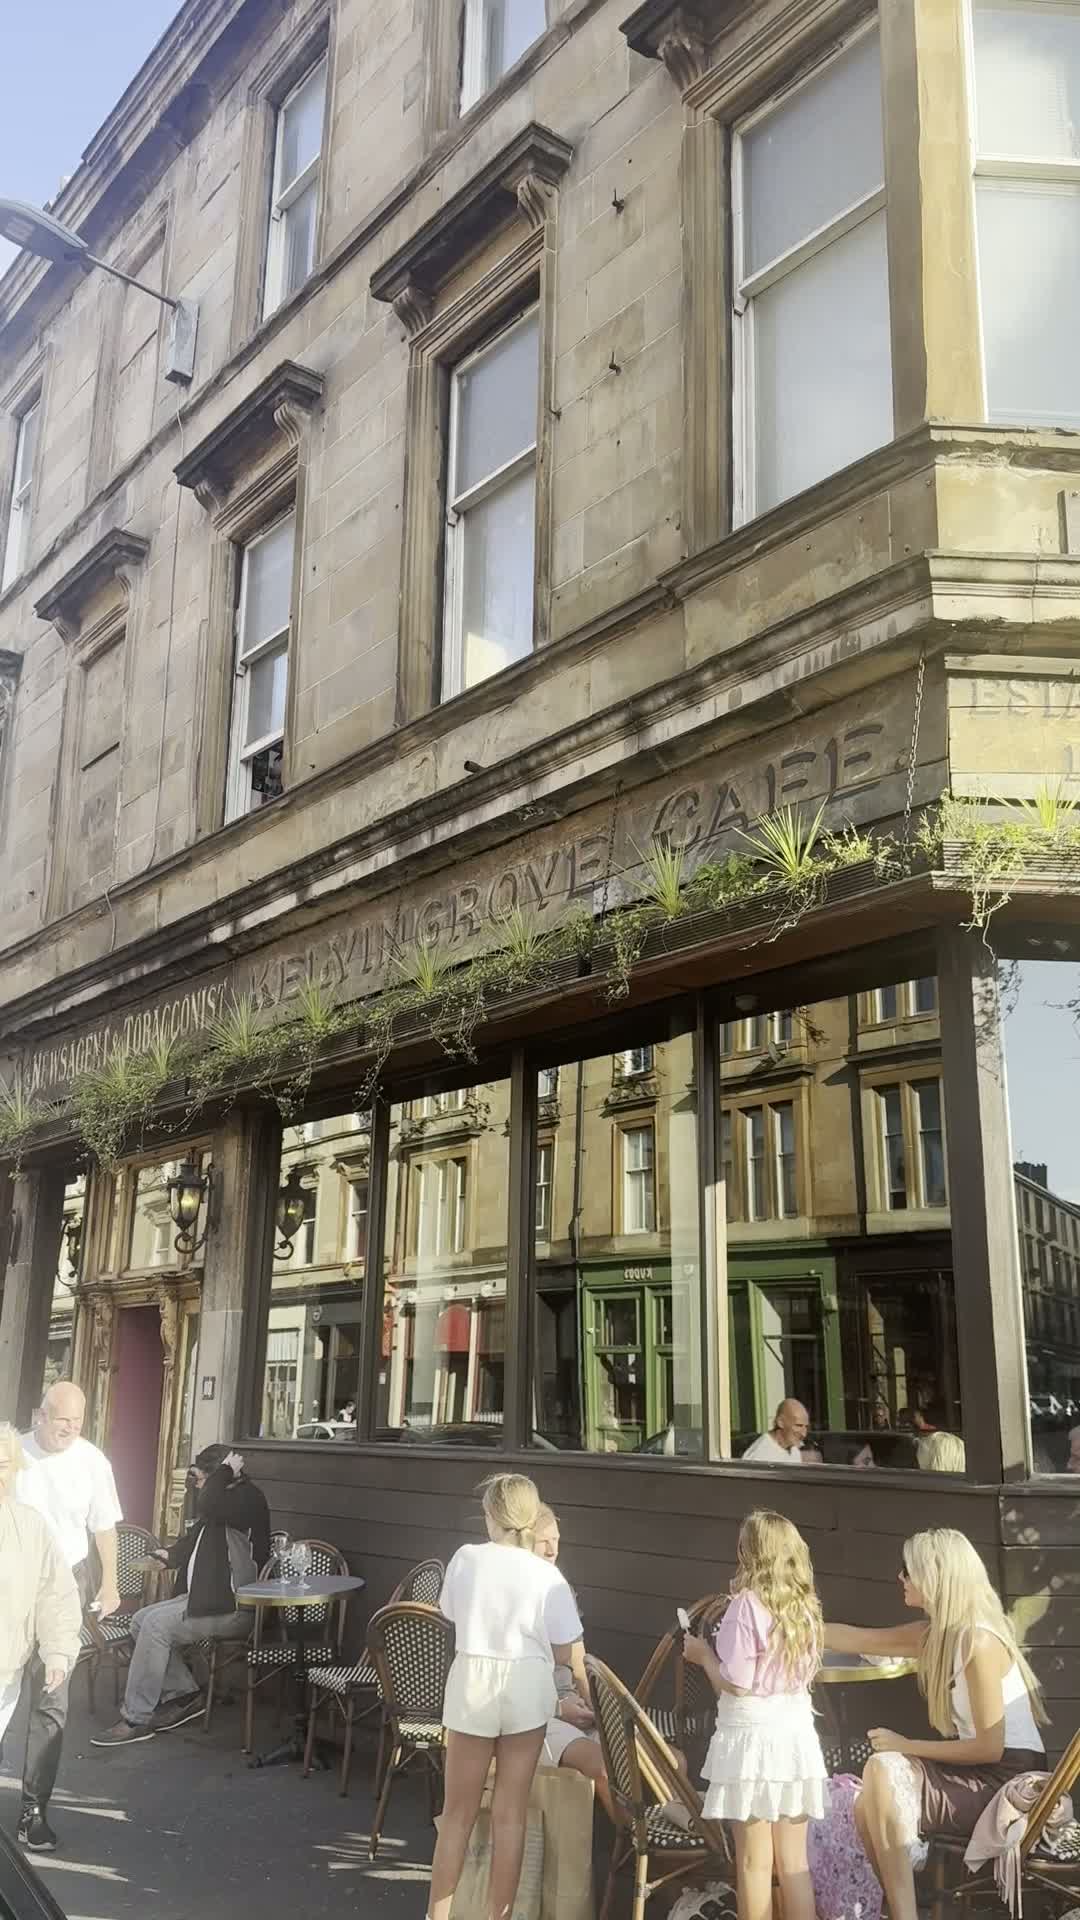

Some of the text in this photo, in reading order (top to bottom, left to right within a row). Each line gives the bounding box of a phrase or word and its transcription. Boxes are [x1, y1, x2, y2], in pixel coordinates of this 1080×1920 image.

[250, 722, 885, 1010] KELVINGROVE CAFE
[31, 1027, 110, 1091] NEWSAGENT
[123, 977, 229, 1055] TOBACCONIST
